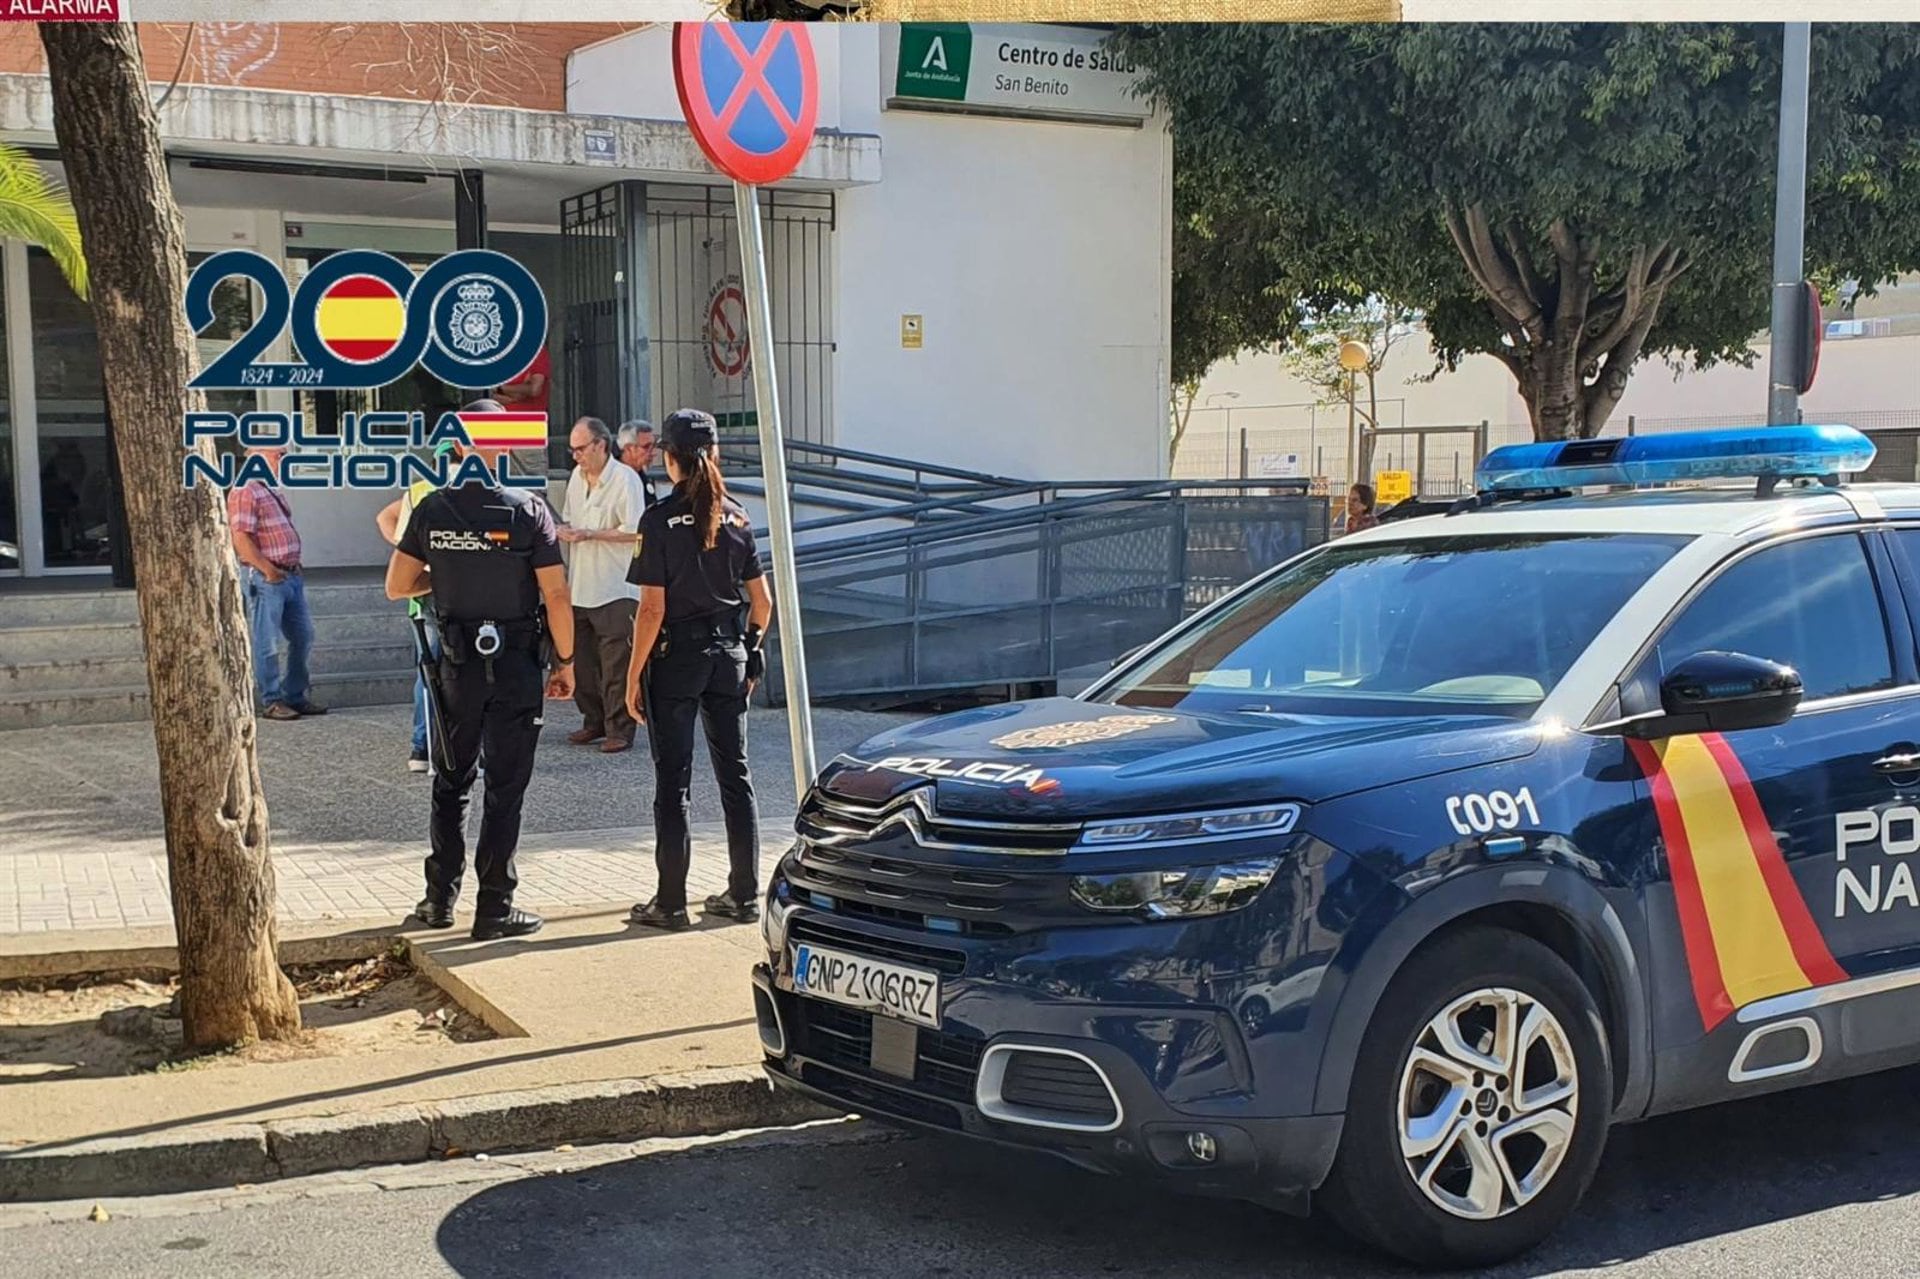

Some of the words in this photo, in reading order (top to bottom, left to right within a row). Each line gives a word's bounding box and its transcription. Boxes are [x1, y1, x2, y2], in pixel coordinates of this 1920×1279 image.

[9, 0, 113, 14] ALARMA
[998, 42, 1058, 67] Centro
[1063, 47, 1085, 69] de
[995, 74, 1020, 92] San
[1025, 76, 1069, 96] Benito
[430, 530, 493, 541] POLICA
[1463, 786, 1540, 833] 091
